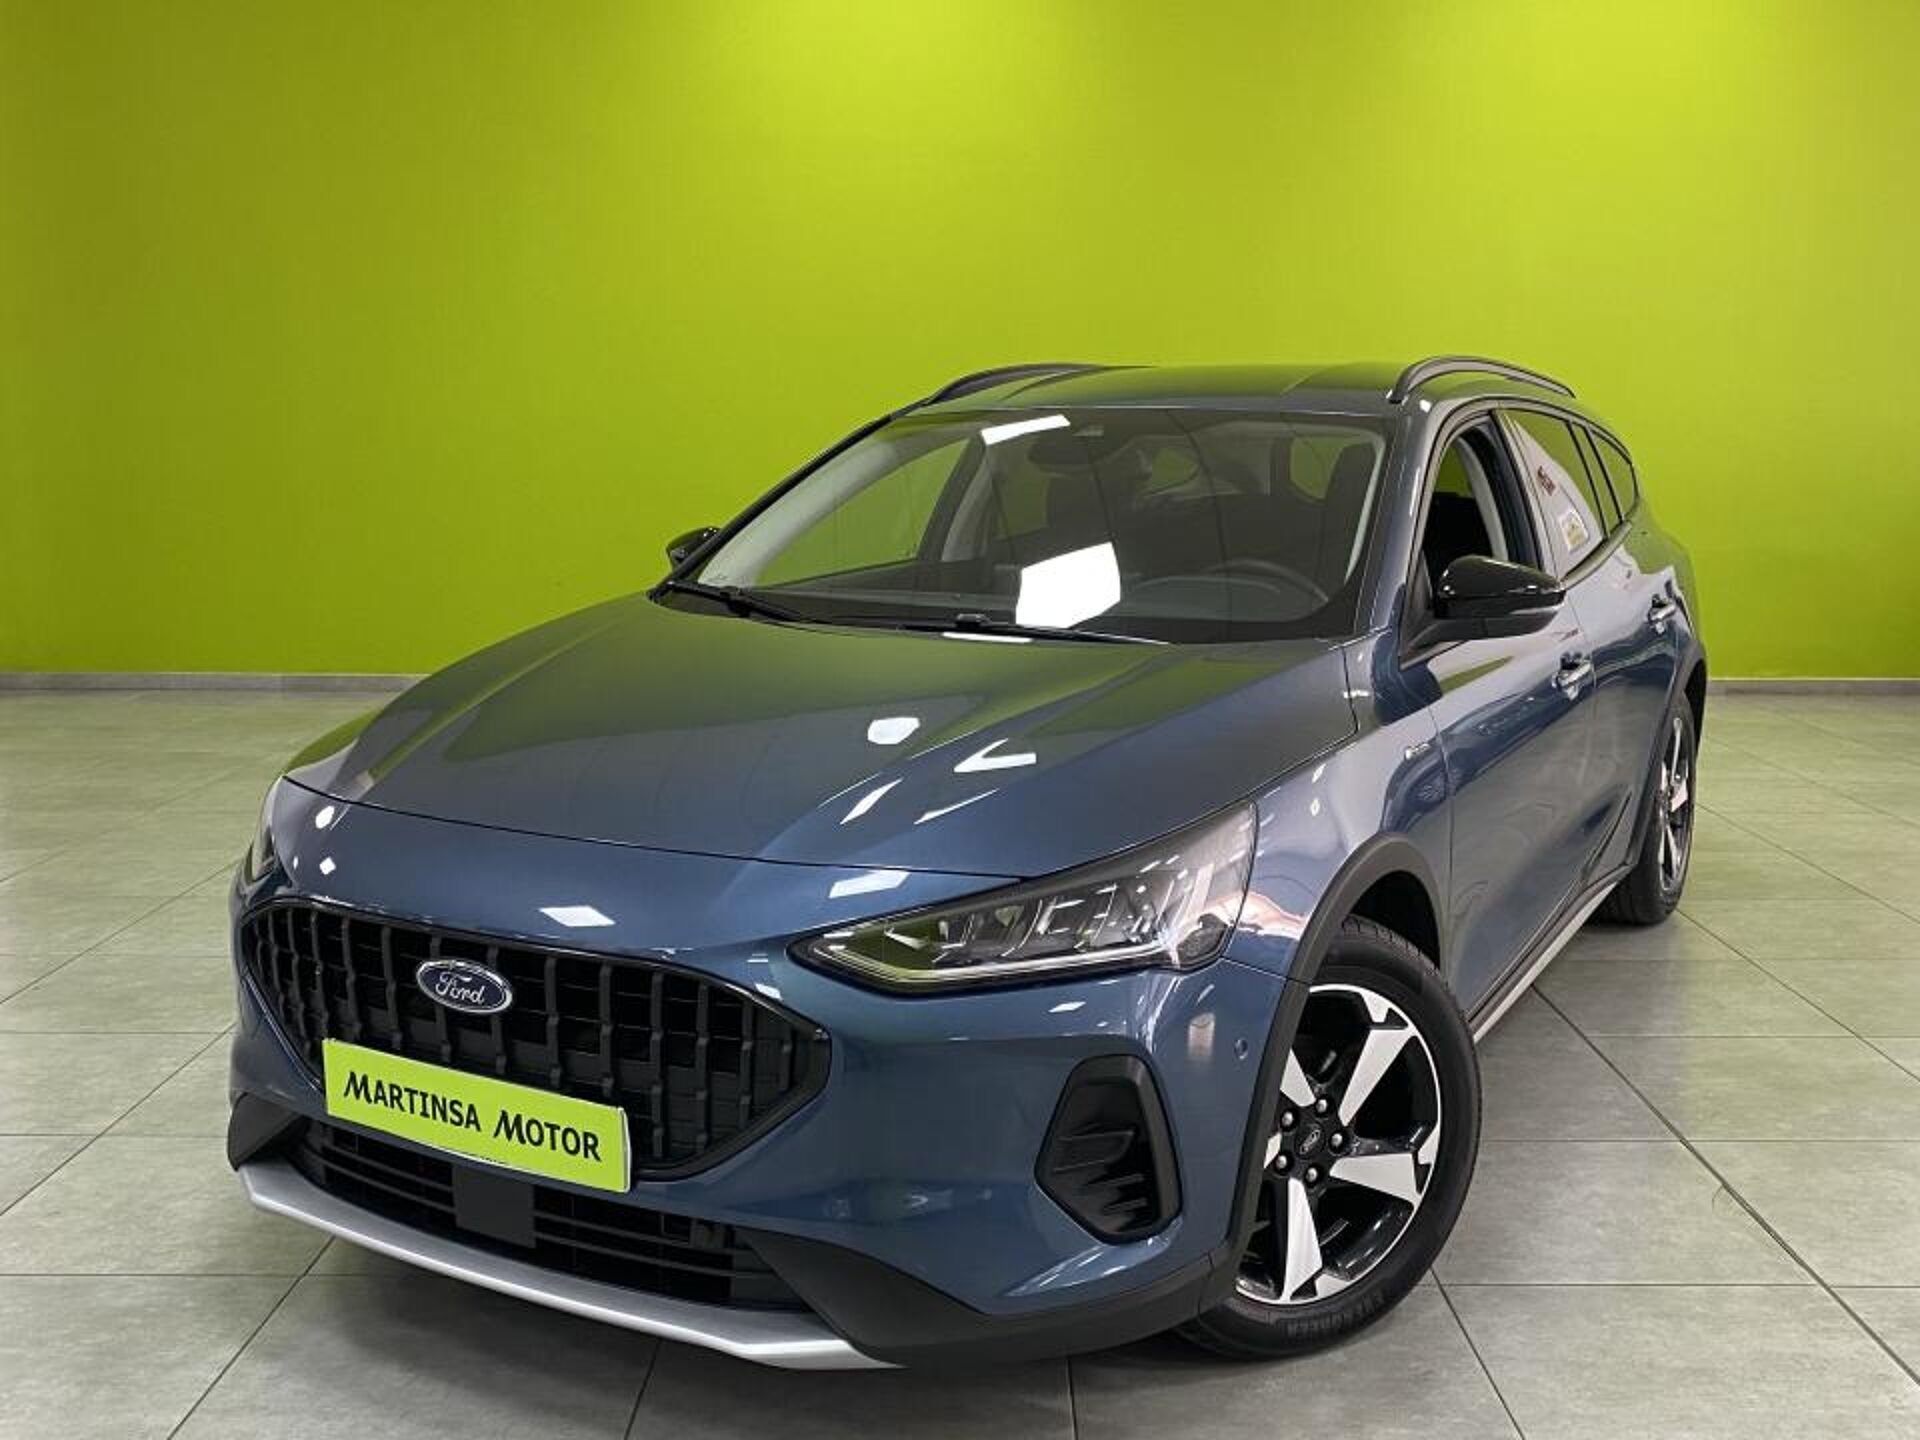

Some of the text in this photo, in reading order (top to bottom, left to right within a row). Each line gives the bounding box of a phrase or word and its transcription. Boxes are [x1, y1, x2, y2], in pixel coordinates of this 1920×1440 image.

[436, 971, 485, 1004] Ford
[344, 1072, 601, 1161] MARTINSA MOTOR
